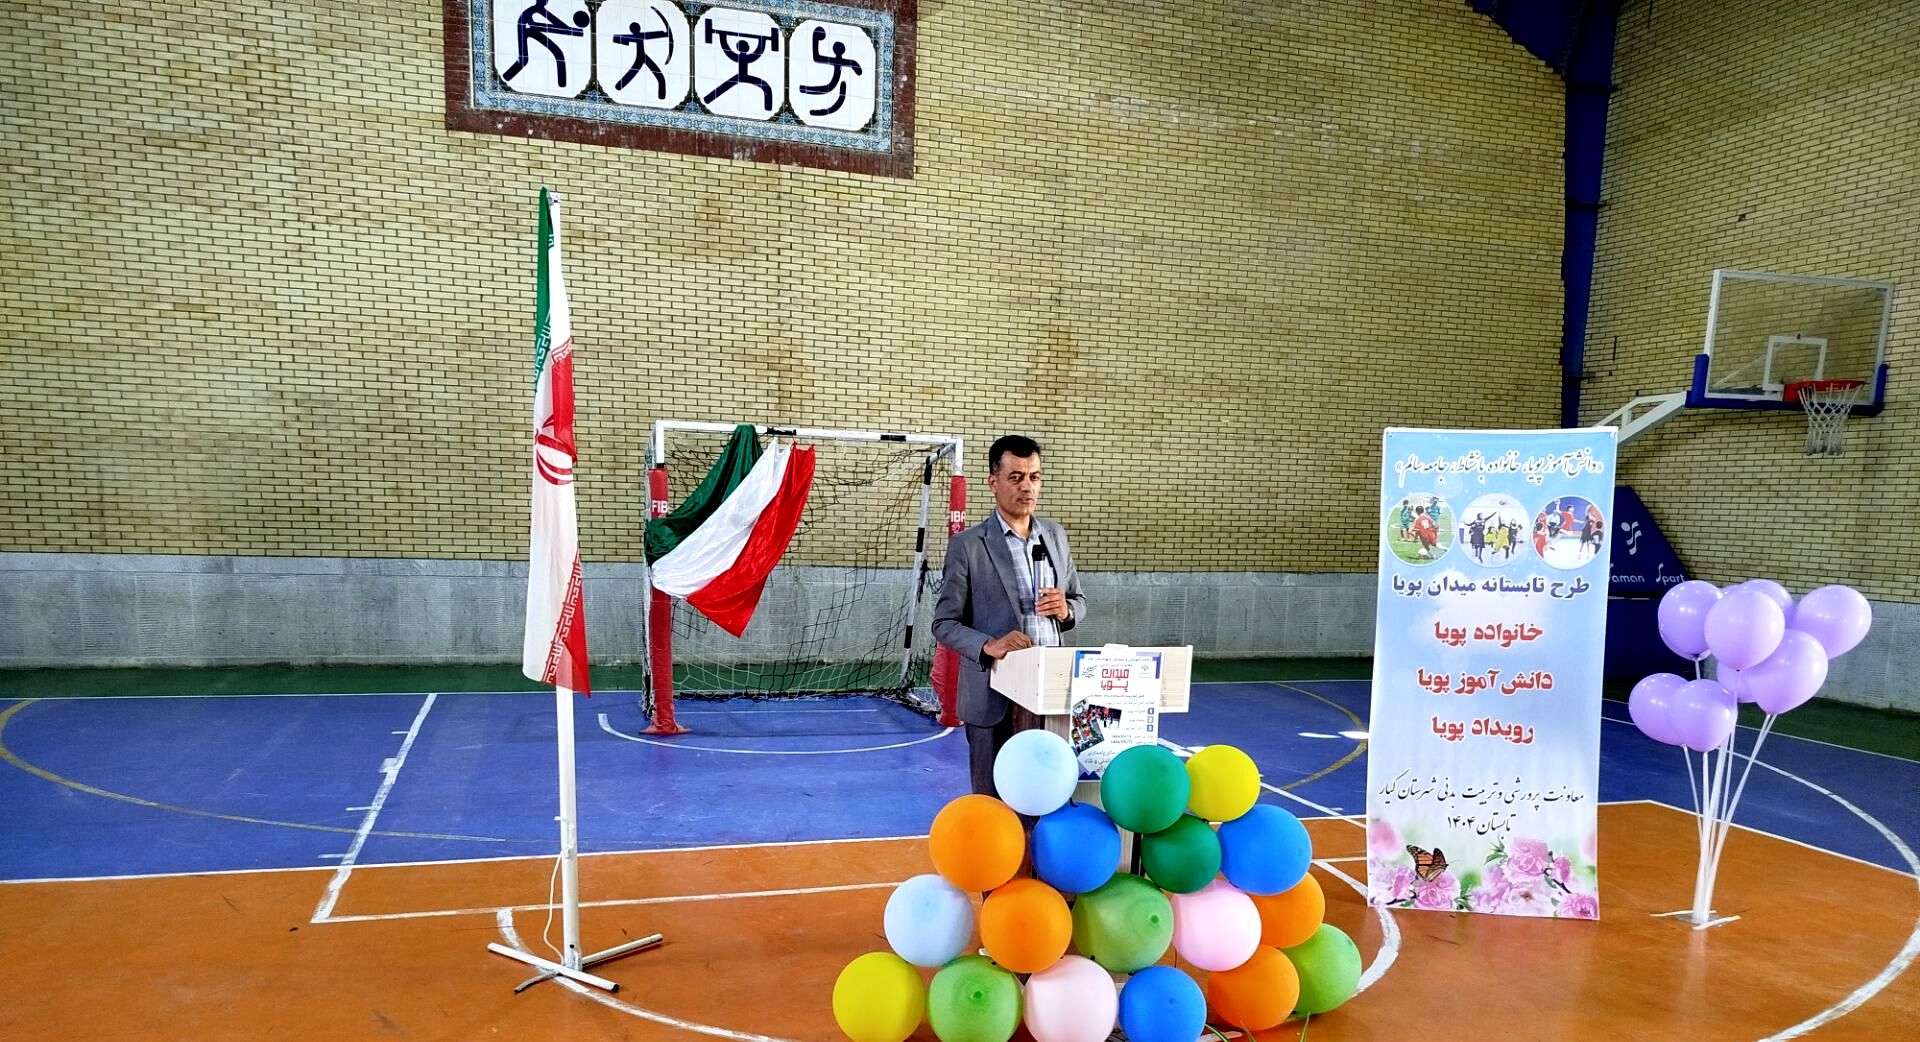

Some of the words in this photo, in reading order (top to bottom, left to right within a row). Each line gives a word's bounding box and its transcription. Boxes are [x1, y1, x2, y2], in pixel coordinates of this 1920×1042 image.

[1424, 456, 1448, 482] جامعه
[1488, 451, 1520, 472] خانواده
[652, 500, 668, 513] FIB
[947, 510, 966, 523] IBA
[1393, 575, 1422, 596] پویا
[1428, 576, 1476, 596] میدان
[1482, 576, 1545, 597] تابستانه
[1551, 577, 1590, 598] طرح
[1434, 621, 1466, 646] پویا
[1474, 622, 1543, 647] خانواده
[1101, 680, 1128, 692] پویا
[1417, 669, 1449, 693] پویا
[1455, 669, 1500, 694] آموز
[1501, 671, 1553, 694] دانش
[1432, 717, 1464, 741] پویا
[1472, 718, 1533, 743] رویداد
[1379, 769, 1409, 804] کیار
[1398, 776, 1437, 800] شهرستان
[1437, 777, 1456, 808] بدنی
[1503, 777, 1540, 810] پرورشی
[1543, 785, 1584, 802] معاونت
[1447, 816, 1475, 829] ۱۴۰۴
[1476, 812, 1517, 840] تابستان
